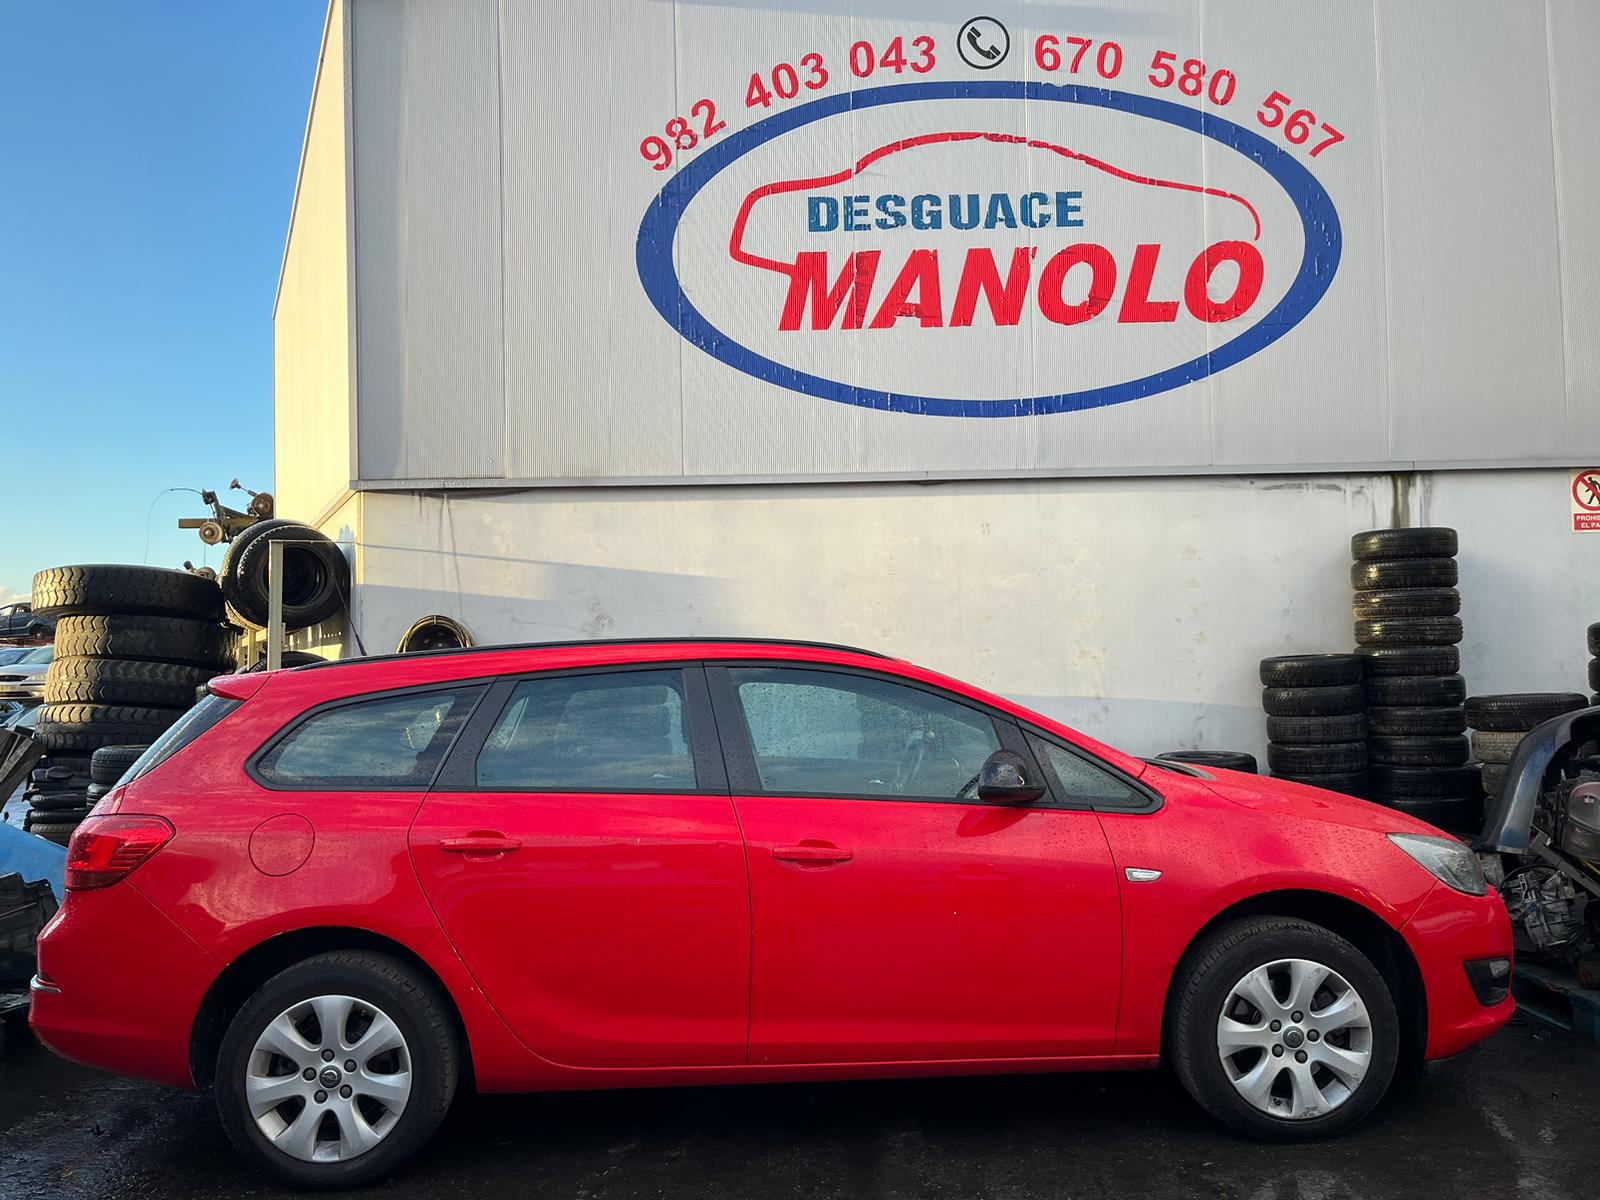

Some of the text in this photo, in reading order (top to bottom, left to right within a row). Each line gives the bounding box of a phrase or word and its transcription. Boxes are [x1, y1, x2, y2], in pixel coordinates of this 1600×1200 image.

[641, 36, 937, 171] 982 403 043
[1034, 34, 1345, 158] 670 580 567
[807, 190, 1085, 232] DESGUACE
[778, 240, 1266, 332] MANOLO
